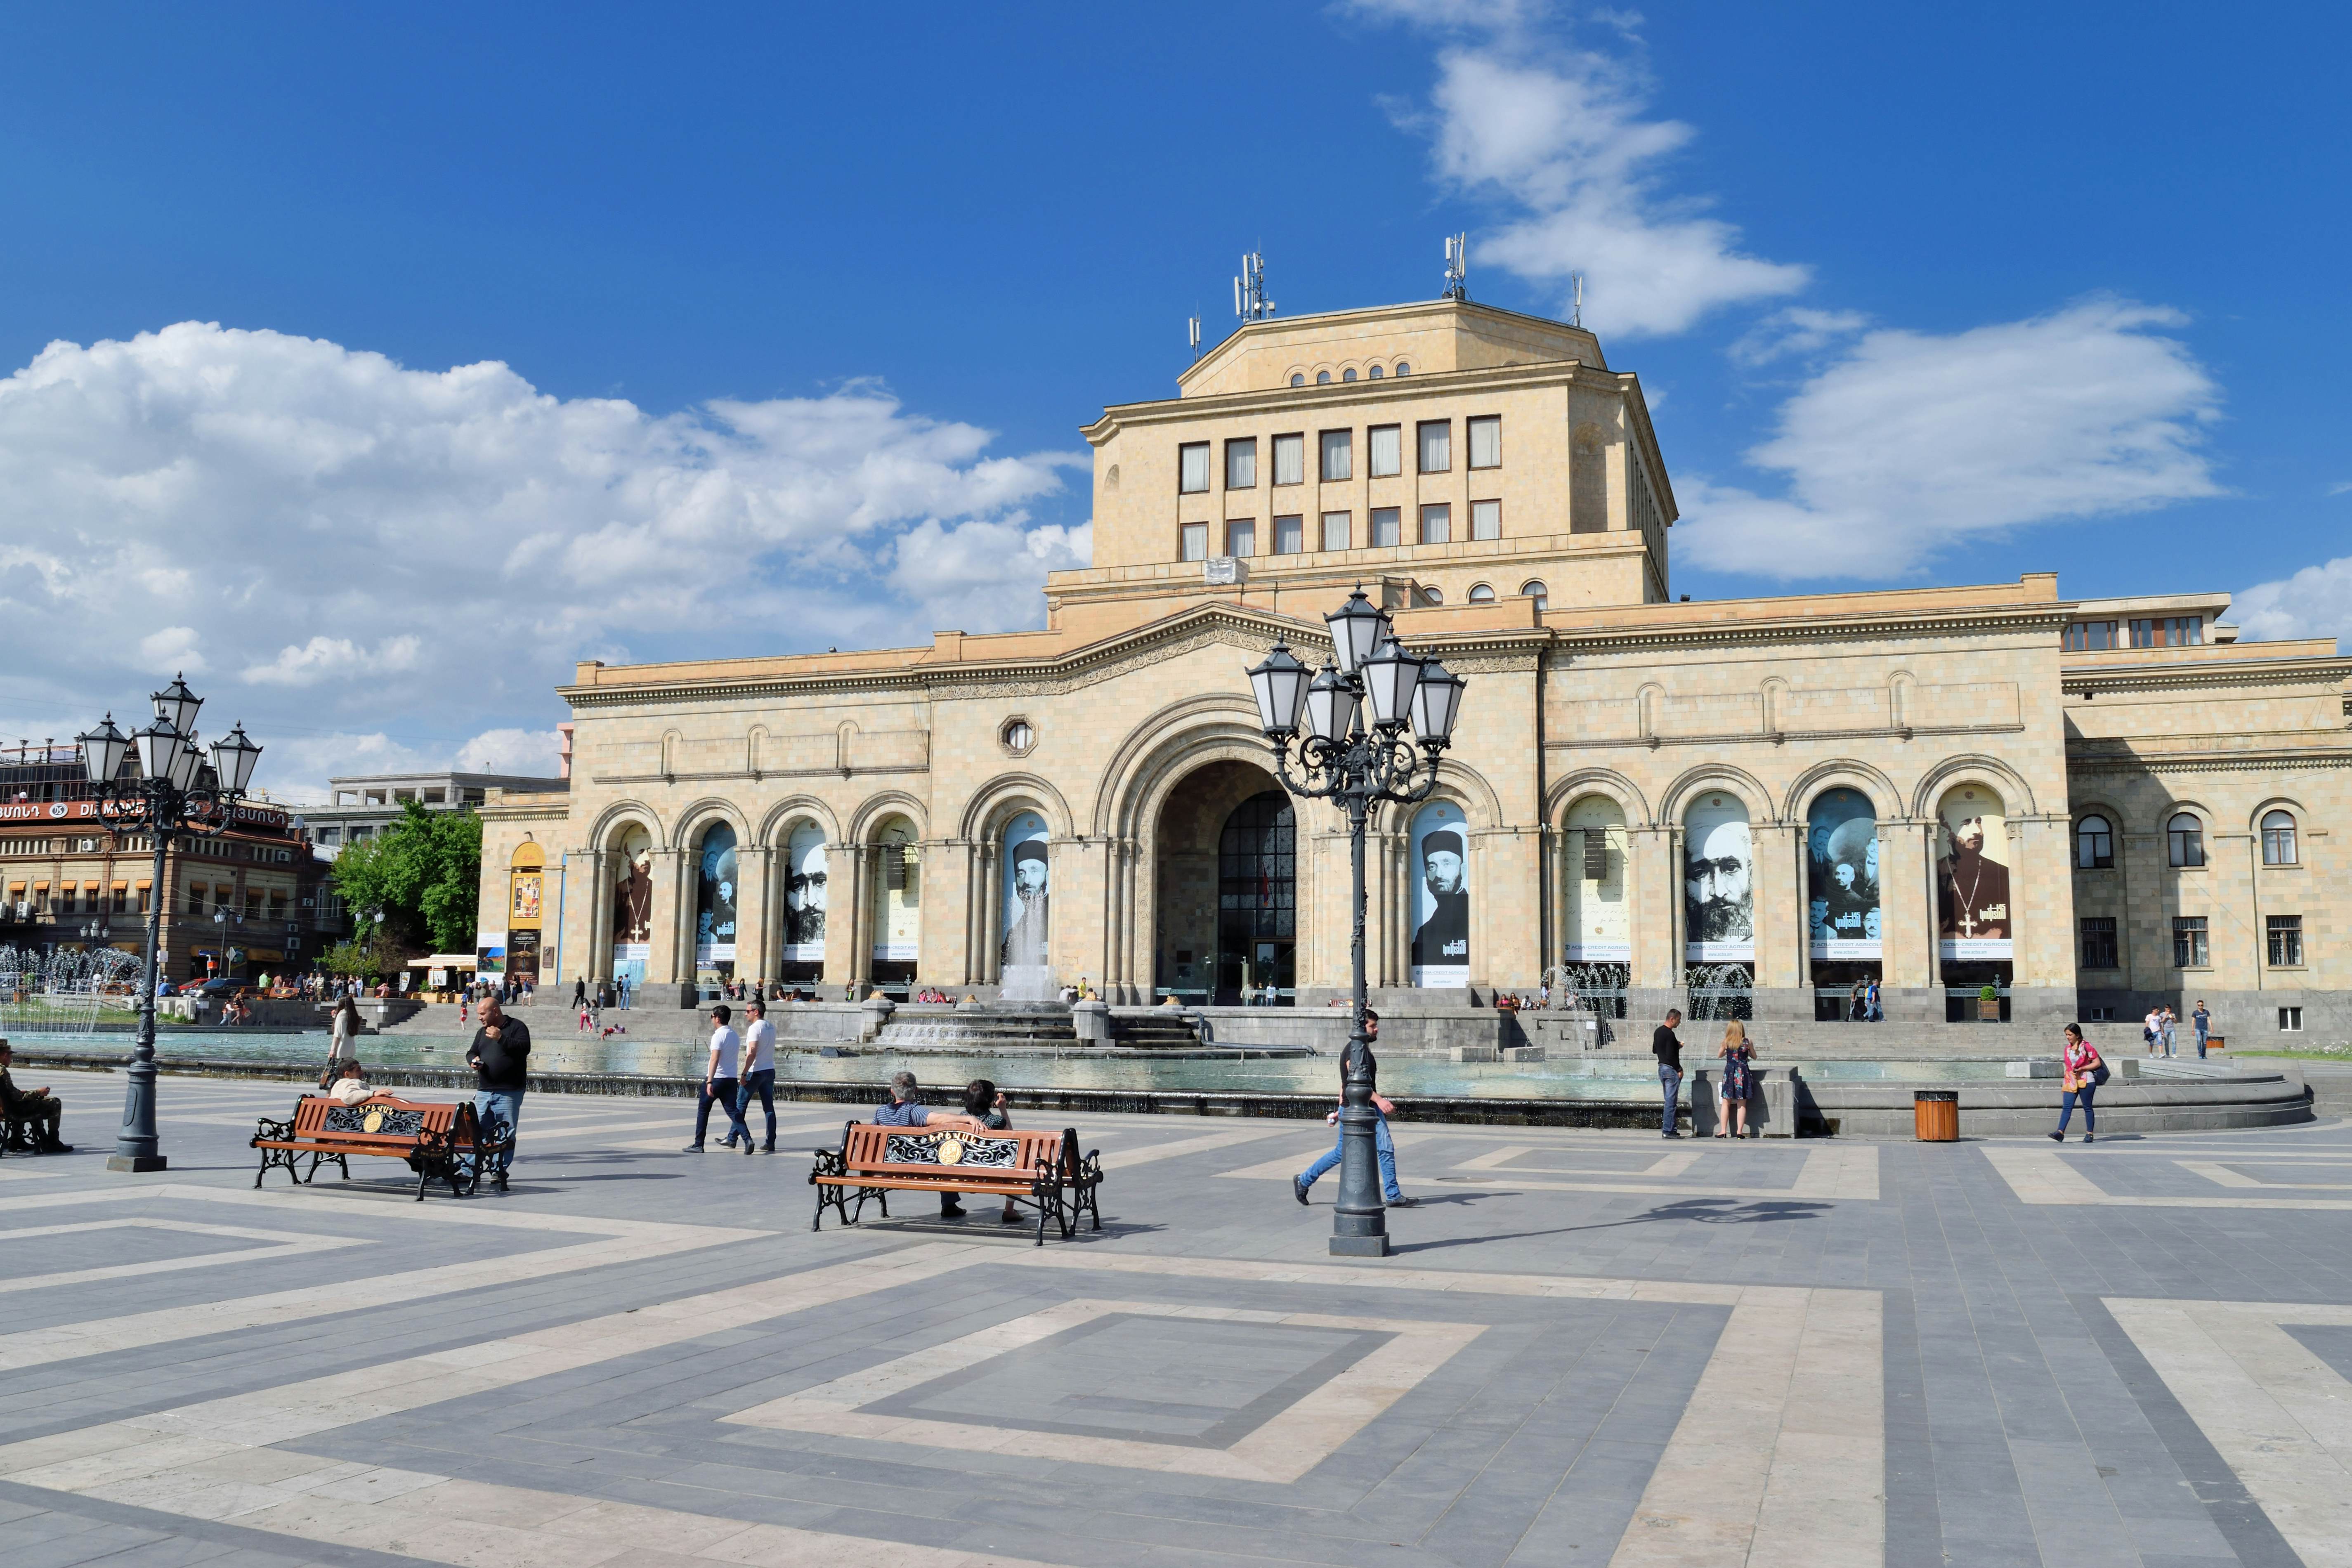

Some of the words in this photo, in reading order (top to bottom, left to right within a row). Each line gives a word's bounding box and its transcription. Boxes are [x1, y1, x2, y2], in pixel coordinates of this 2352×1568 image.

[80, 802, 145, 815] DIMOND
[217, 805, 286, 825] ԴՅՄՈՆԴ
[359, 1105, 394, 1115] ԵՐԵՎԱՆ
[929, 1132, 976, 1143] ԵՐԵՎԱՆ
